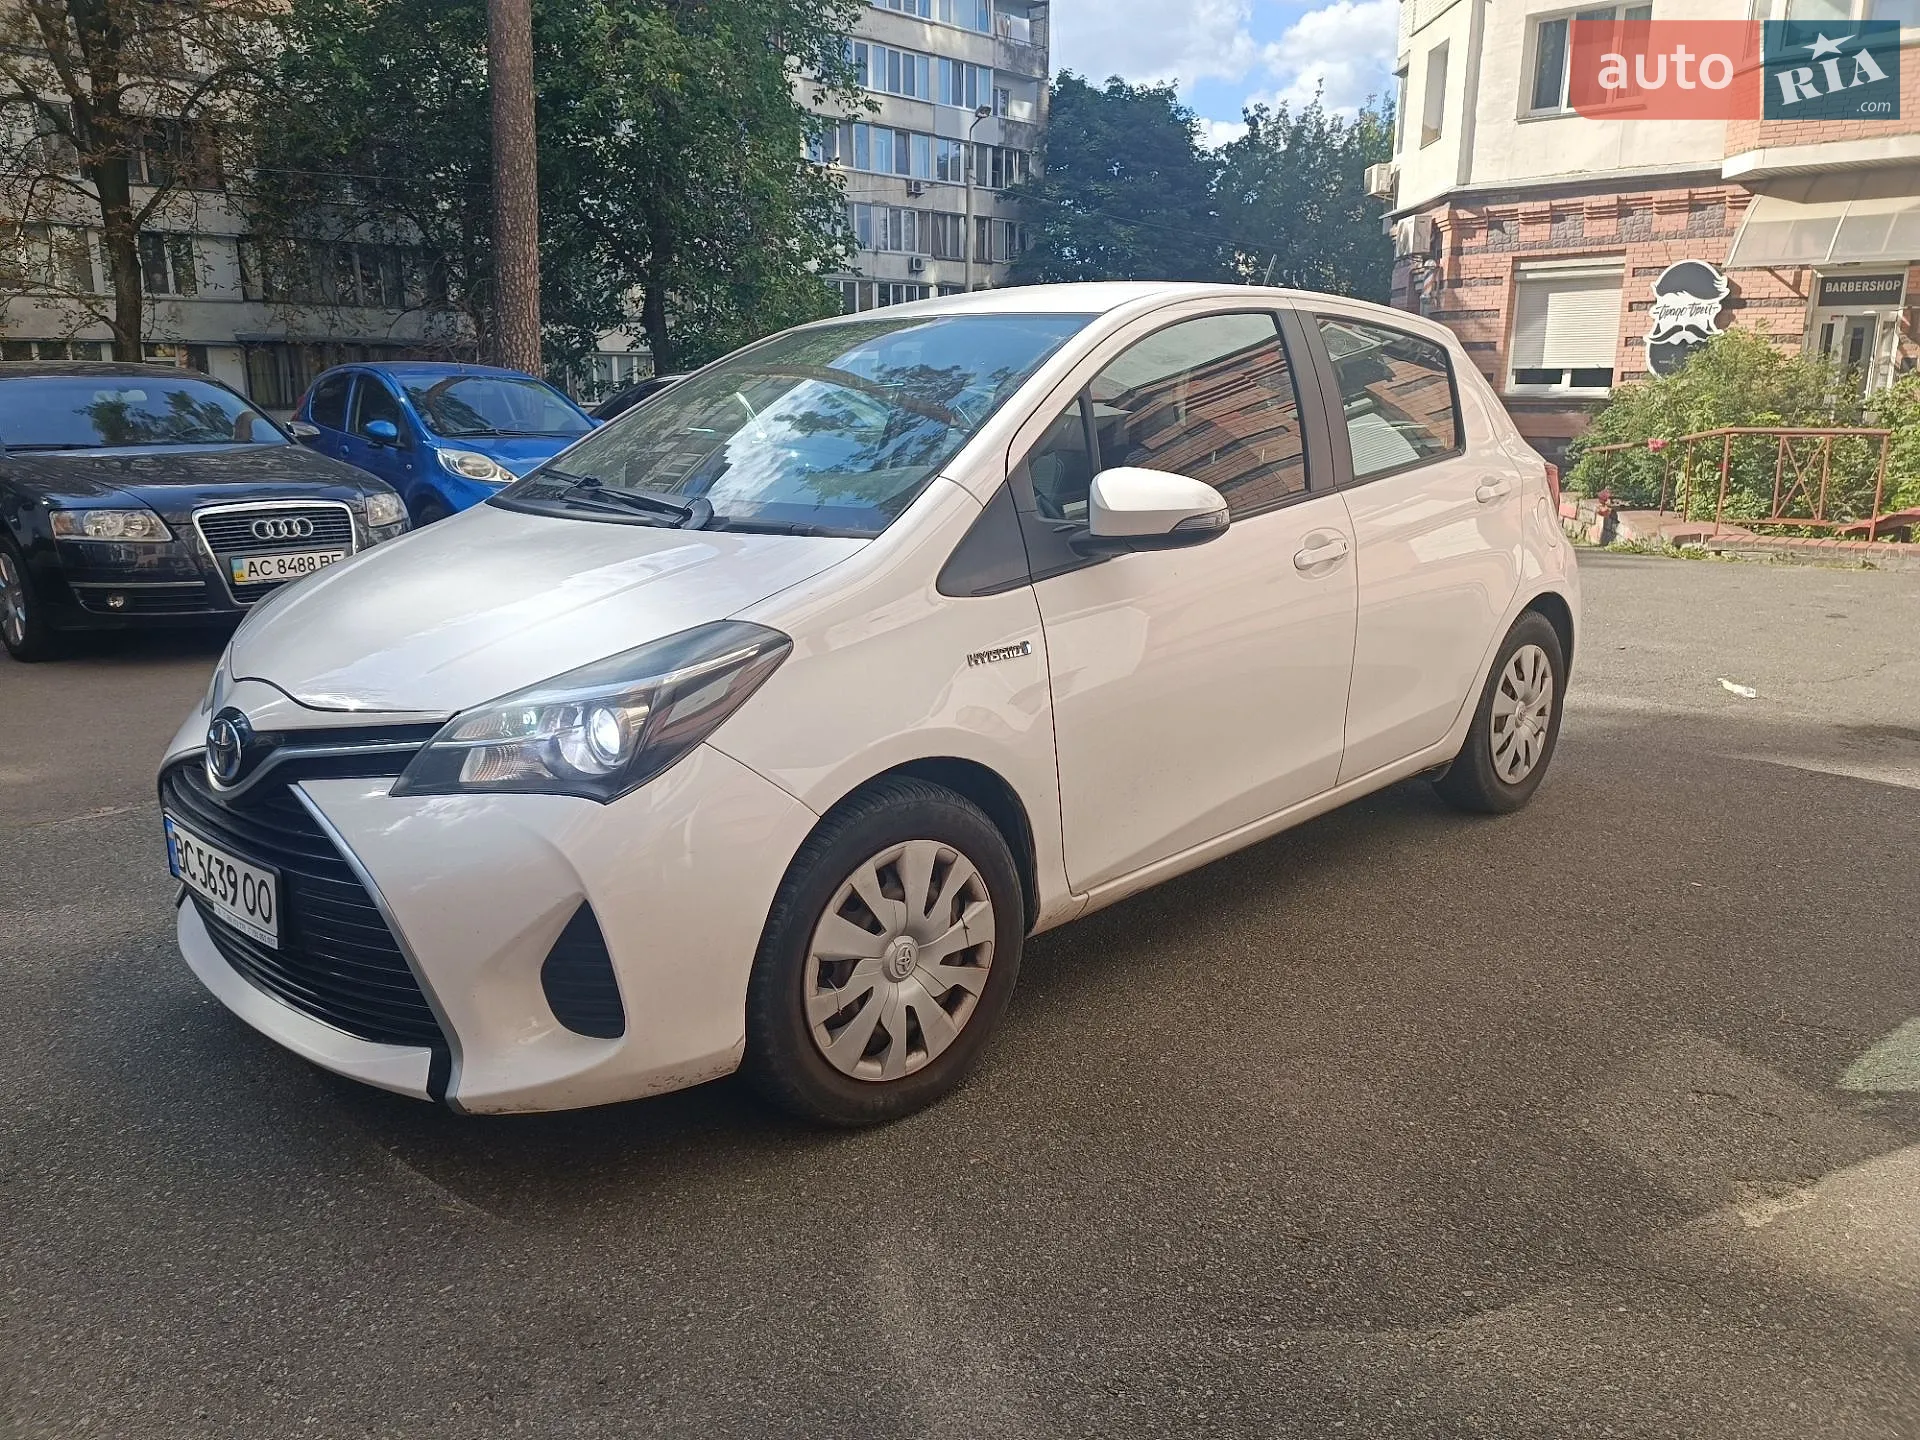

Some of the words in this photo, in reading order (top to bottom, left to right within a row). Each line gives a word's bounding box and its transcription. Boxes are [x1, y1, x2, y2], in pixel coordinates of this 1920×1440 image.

[1825, 279, 1901, 293] BARBERSHOP
[248, 560, 272, 577] AC
[277, 556, 316, 575] 8488
[967, 640, 1032, 668] HYBRID
[174, 831, 196, 881] BC
[196, 846, 238, 907] 5639
